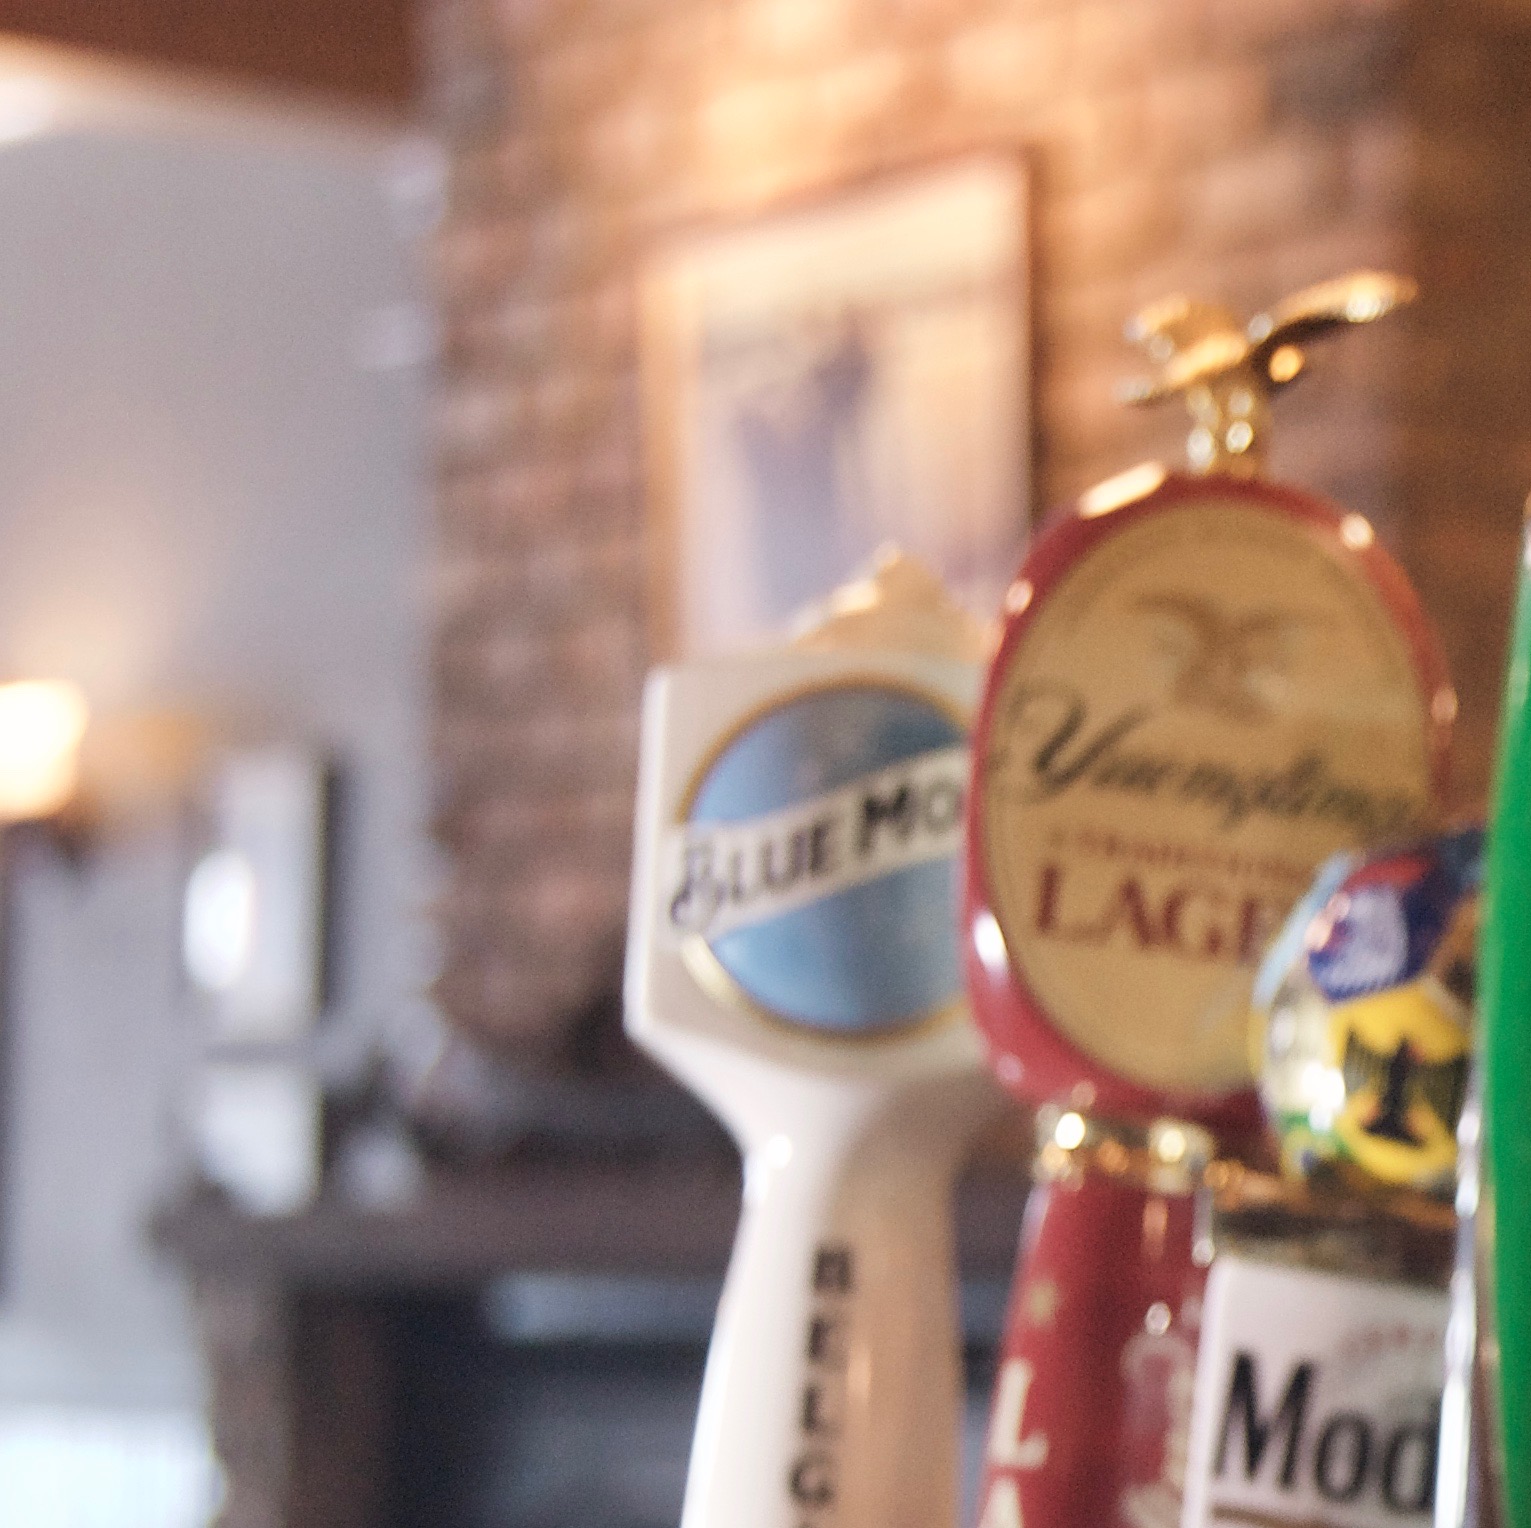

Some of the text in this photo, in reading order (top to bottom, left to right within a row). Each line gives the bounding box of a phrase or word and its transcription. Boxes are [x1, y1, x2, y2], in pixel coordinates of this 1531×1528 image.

[669, 818, 832, 930] BLUE
[855, 777, 965, 860] MO
[1033, 862, 1278, 966] LAGE
[1210, 1345, 1440, 1515] Mod
